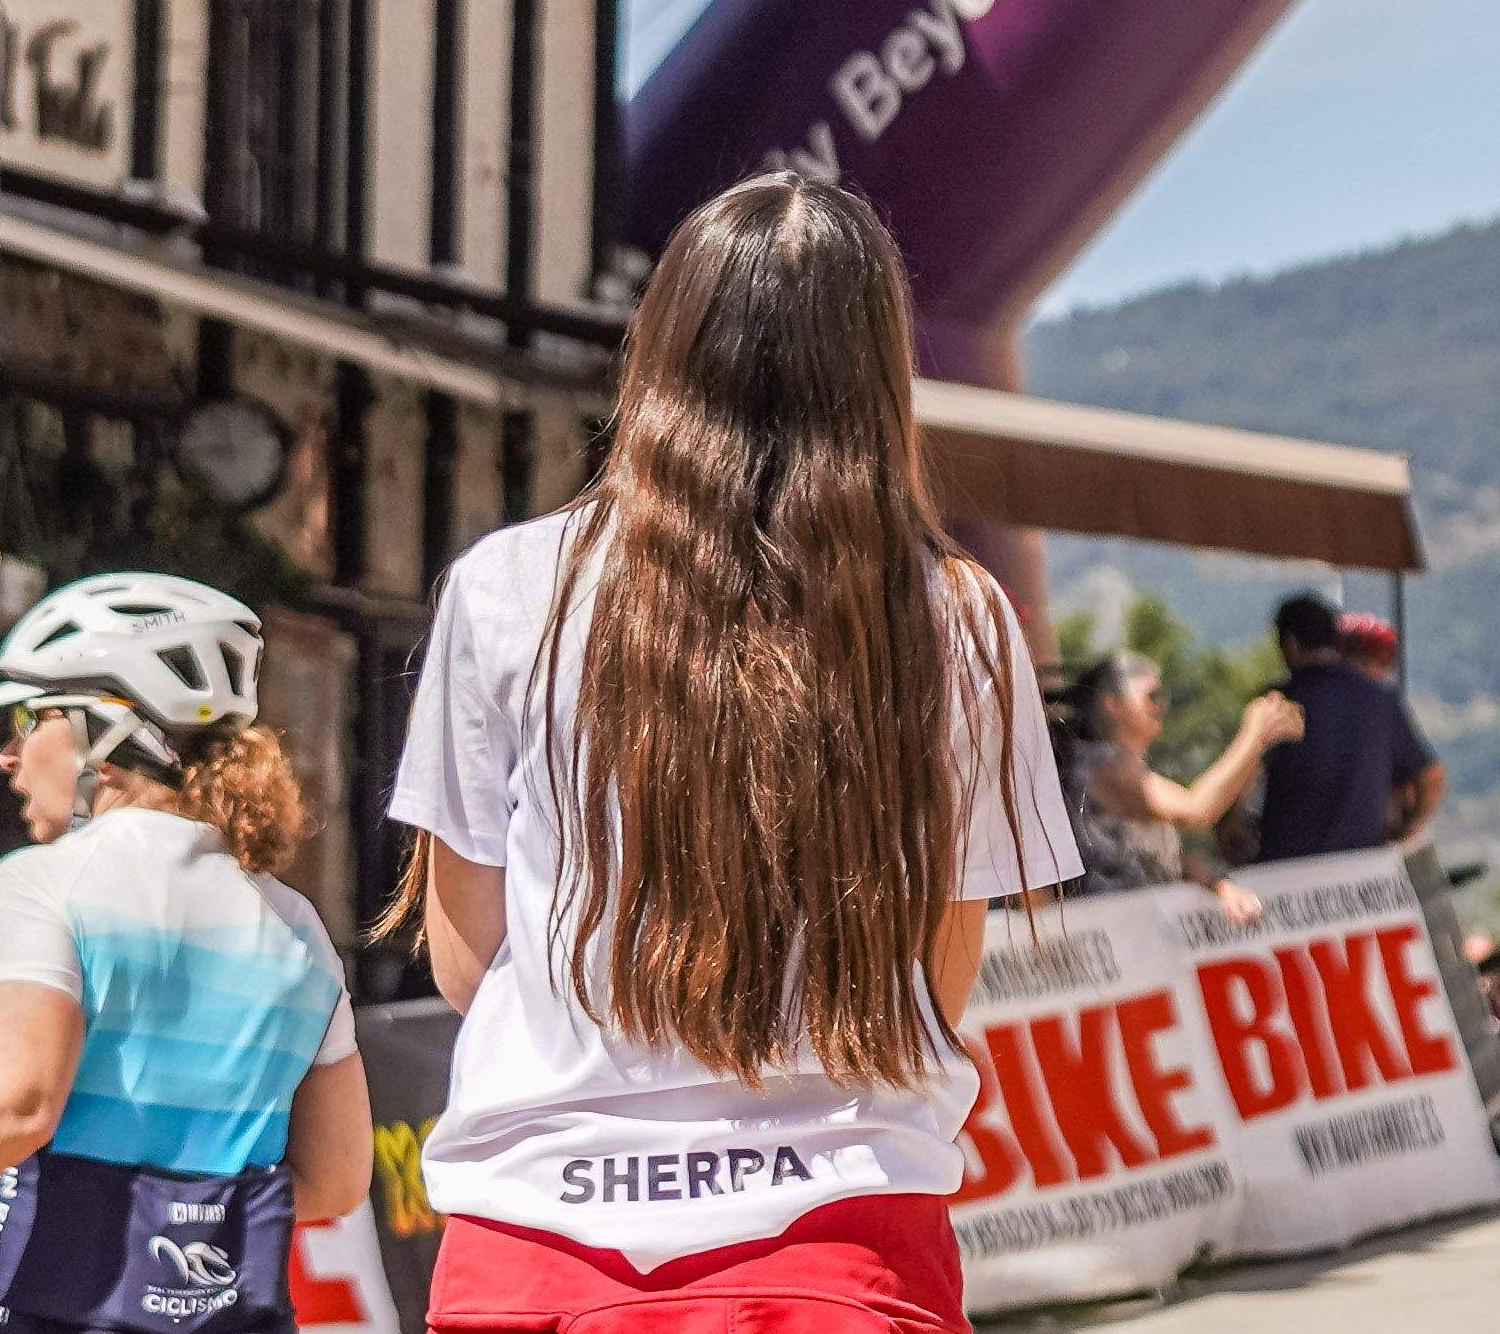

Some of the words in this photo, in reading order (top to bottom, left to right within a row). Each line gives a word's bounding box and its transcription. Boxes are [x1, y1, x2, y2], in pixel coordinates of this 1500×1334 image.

[1196, 924, 1461, 1123] BIKE
[560, 1145, 814, 1204] SHERPA
[142, 1288, 238, 1316] CICLISMO
